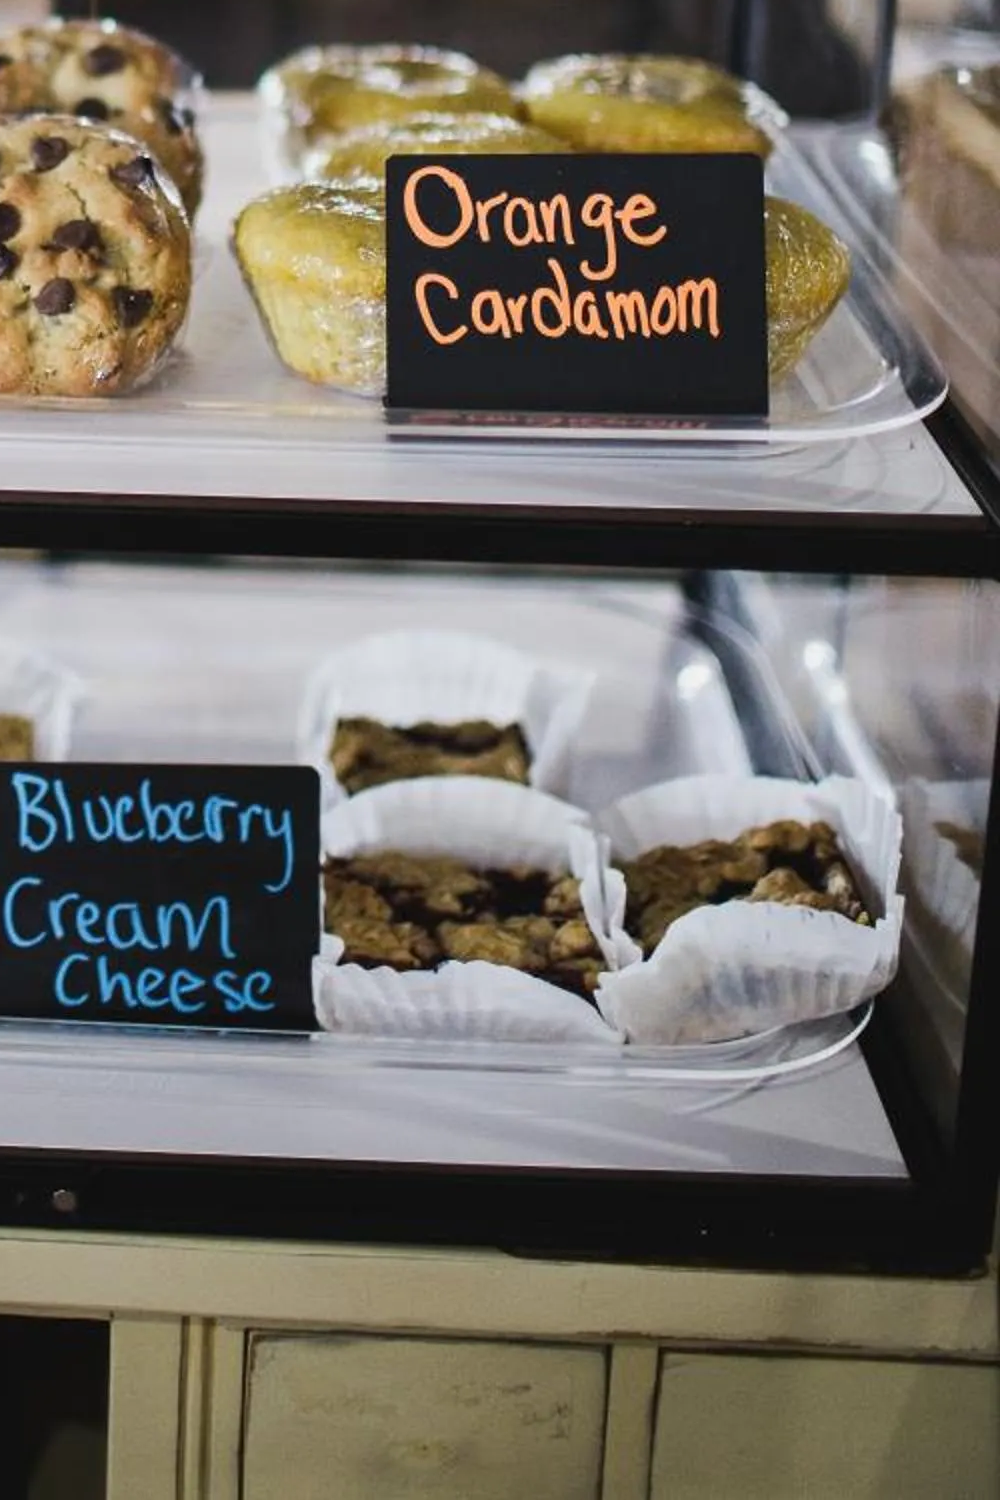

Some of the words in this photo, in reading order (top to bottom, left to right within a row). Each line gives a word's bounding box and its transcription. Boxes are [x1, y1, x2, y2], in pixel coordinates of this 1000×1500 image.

[404, 165, 667, 281] Orange
[414, 258, 721, 345] Cardamom
[12, 771, 294, 893] Blueberry
[3, 877, 237, 958] Cream
[55, 953, 276, 1013] Cheese
